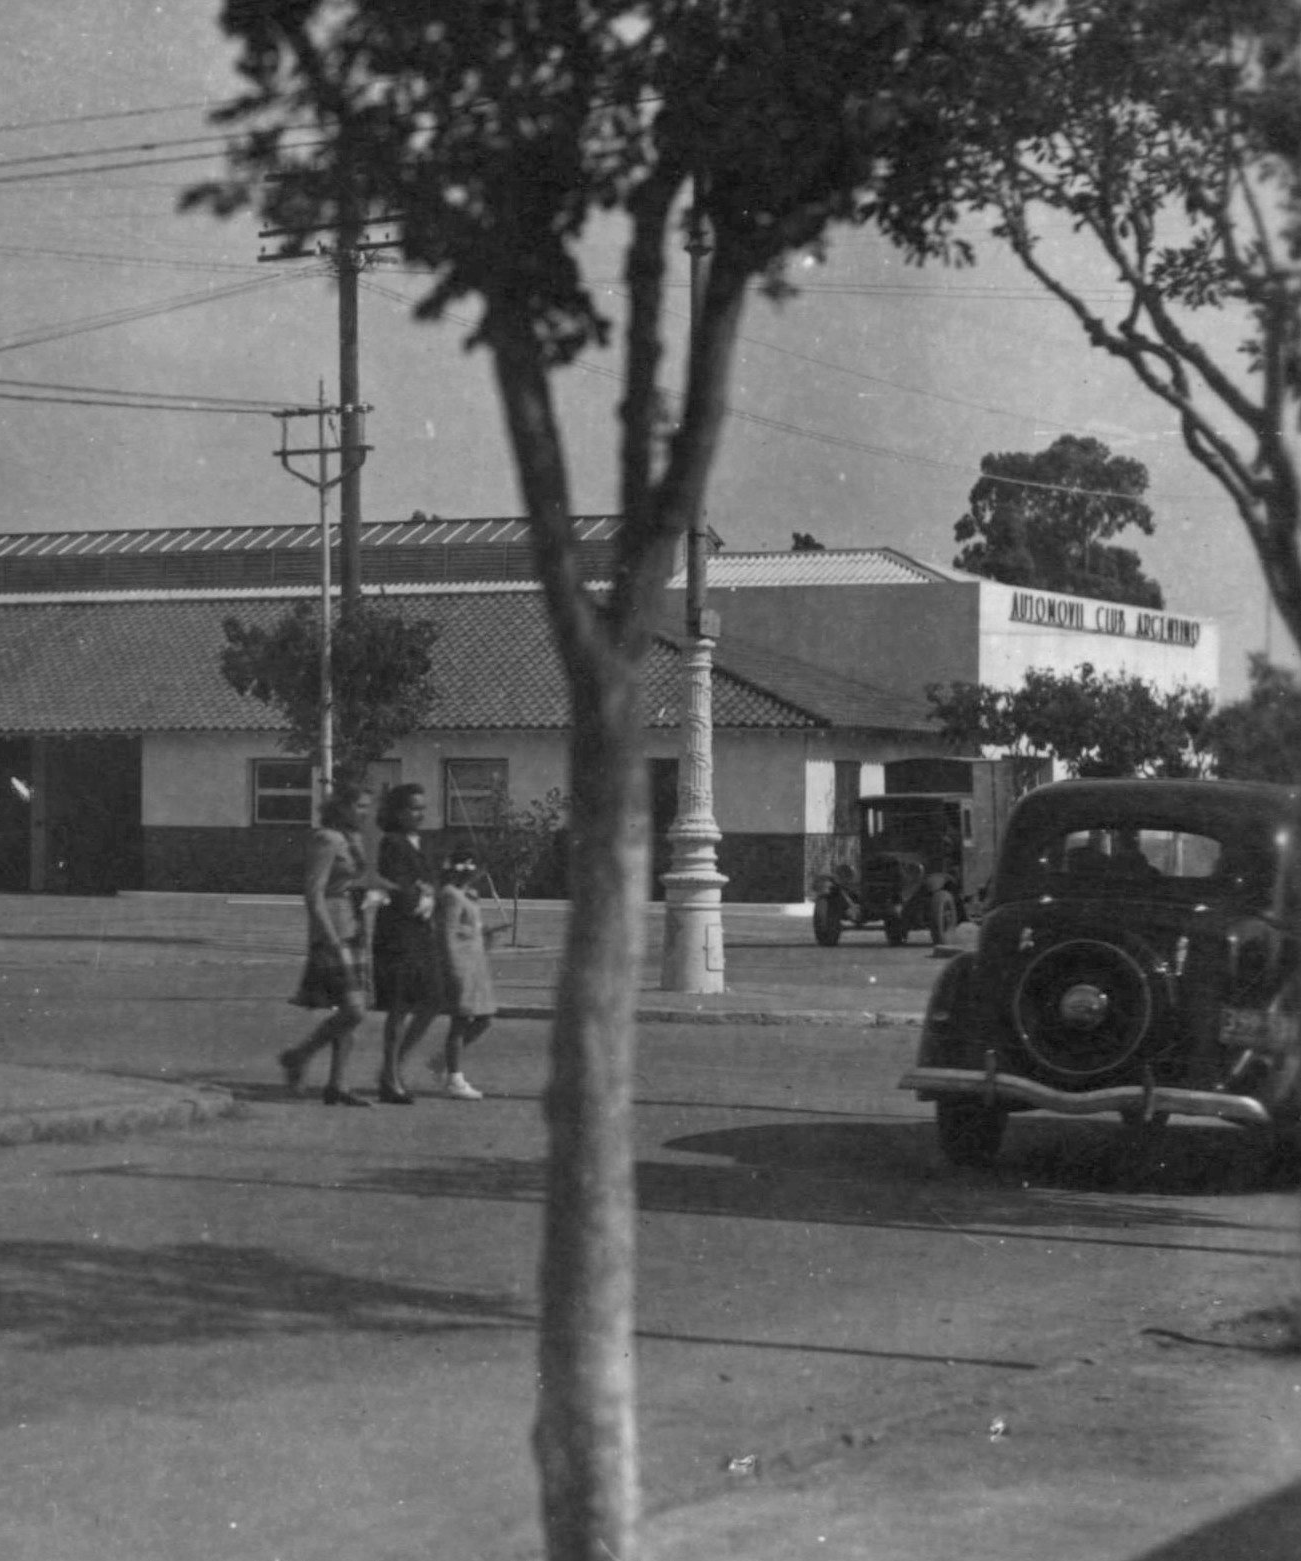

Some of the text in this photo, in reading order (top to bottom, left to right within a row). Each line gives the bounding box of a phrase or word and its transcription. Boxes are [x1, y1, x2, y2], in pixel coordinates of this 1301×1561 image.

[1009, 591, 1201, 648] AUTOMOVIL CLUB ARGENTINO
